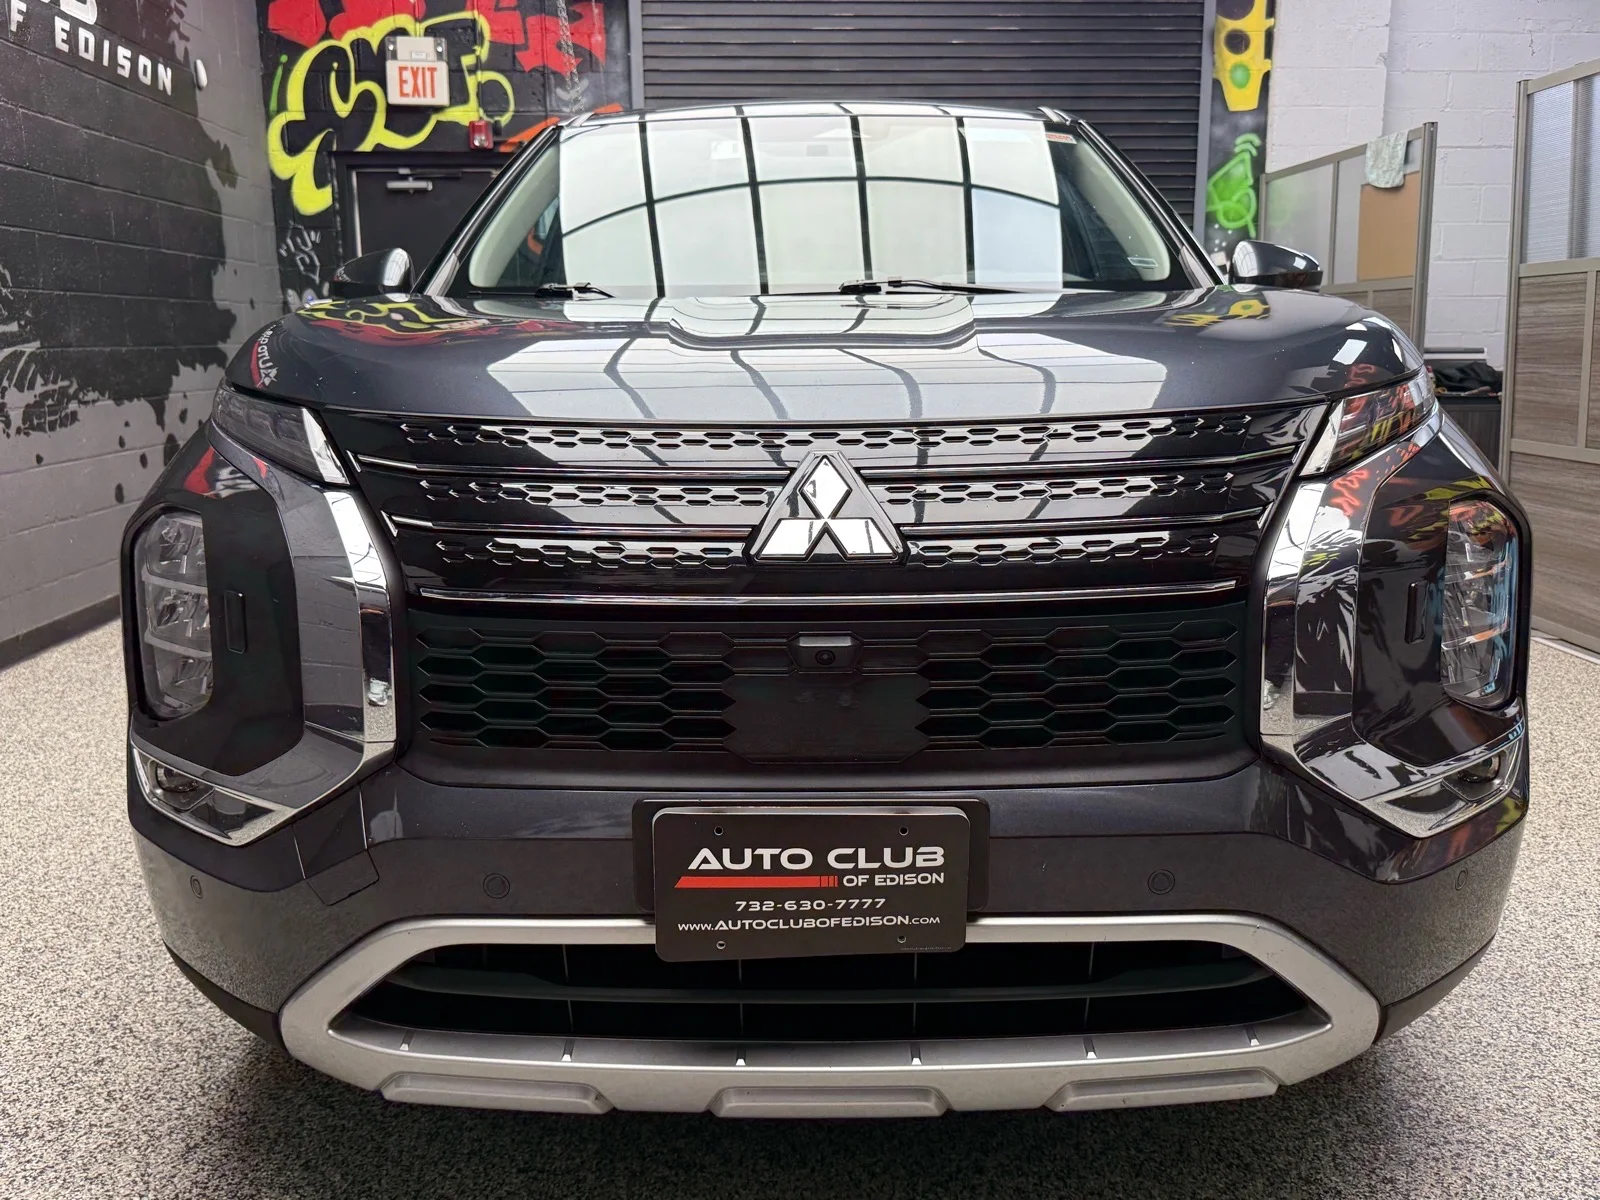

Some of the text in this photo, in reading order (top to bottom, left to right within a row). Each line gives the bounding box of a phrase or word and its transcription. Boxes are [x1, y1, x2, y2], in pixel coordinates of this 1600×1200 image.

[54, 15, 173, 96] EDISON
[398, 66, 438, 99] EXIT
[687, 846, 945, 870] AUTO CLUB
[842, 872, 945, 887] OF EDISON
[735, 898, 886, 912] 732-630-7777
